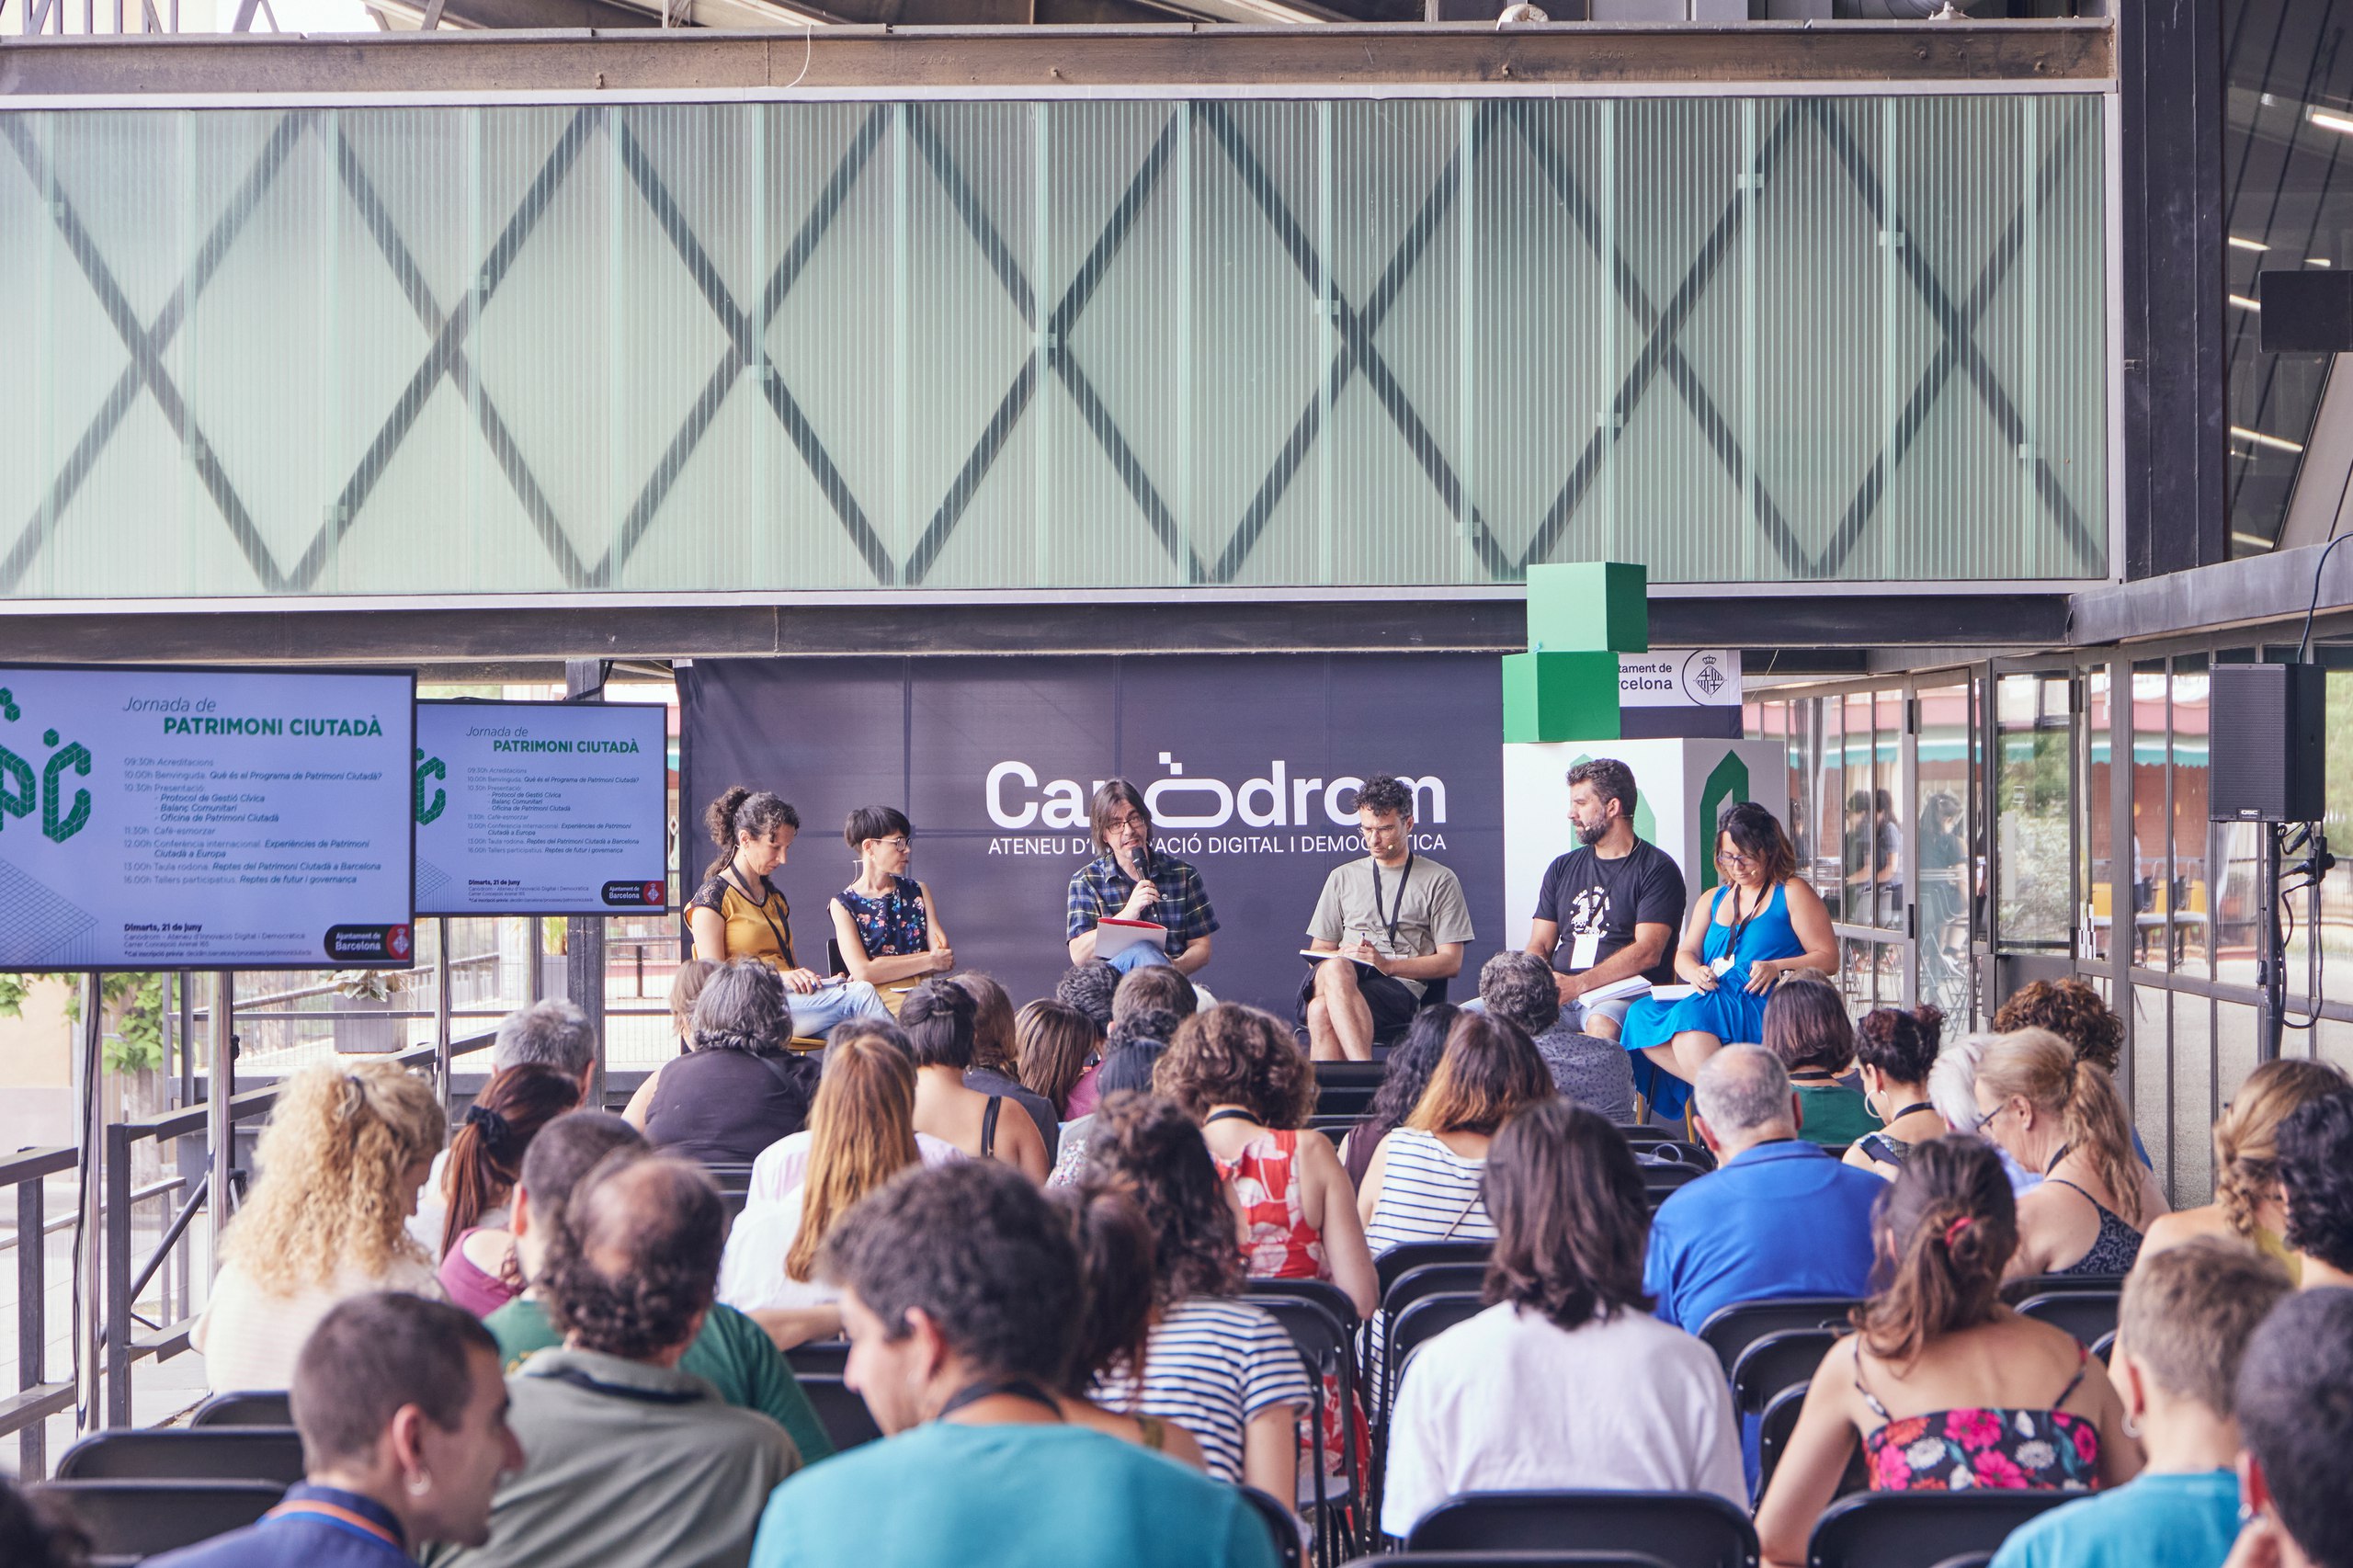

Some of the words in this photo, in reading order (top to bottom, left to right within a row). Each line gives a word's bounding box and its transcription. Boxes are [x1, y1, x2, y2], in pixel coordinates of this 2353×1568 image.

[1619, 663, 1656, 673] tament
[1659, 663, 1672, 673] de
[1619, 676, 1673, 690] celona
[122, 697, 190, 712] Jornada
[196, 697, 216, 712] de
[164, 717, 283, 735] PATRIMONI
[290, 715, 383, 736] CIUTADÀ
[466, 726, 511, 736] Jornada
[514, 726, 529, 736] de
[494, 740, 573, 752] PATRIMONI
[577, 738, 639, 753] CIUTADÀ
[157, 758, 214, 767] Acreditacions
[210, 771, 227, 780] Què
[229, 771, 238, 780] és
[240, 771, 248, 780] el
[250, 772, 290, 782] Programa
[292, 772, 303, 780] de
[305, 772, 344, 780] Patrimoni
[346, 772, 382, 780] Ciutadà?
[986, 752, 1446, 829] Caòdrom
[160, 794, 196, 802] Protocol
[199, 794, 209, 802] de
[211, 794, 238, 802] Gestió
[240, 794, 265, 802] Cívica
[160, 804, 189, 813] Balanç
[191, 804, 238, 812] Comunitari
[160, 813, 190, 822] Oficina
[192, 813, 203, 822] de
[205, 813, 245, 822] Patrimoni
[247, 813, 279, 822] Ciutadà
[988, 838, 1065, 854] ATENEU
[1072, 833, 1202, 855] D'IACIÓ
[1208, 836, 1284, 853] DIGITAL
[1290, 836, 1295, 853] I
[154, 850, 187, 858] Ciutadà
[196, 850, 227, 859] Europa
[154, 863, 176, 871] Taula
[212, 863, 241, 872] Reptes
[244, 862, 256, 871] del
[258, 862, 297, 871] Patrimoni
[300, 862, 331, 871] Ciutadà
[340, 863, 381, 871] Barcelona
[124, 924, 160, 932] Dimarts,
[184, 924, 203, 933] juny
[336, 932, 372, 941] Ajuntament
[335, 941, 381, 951] Barcelona
